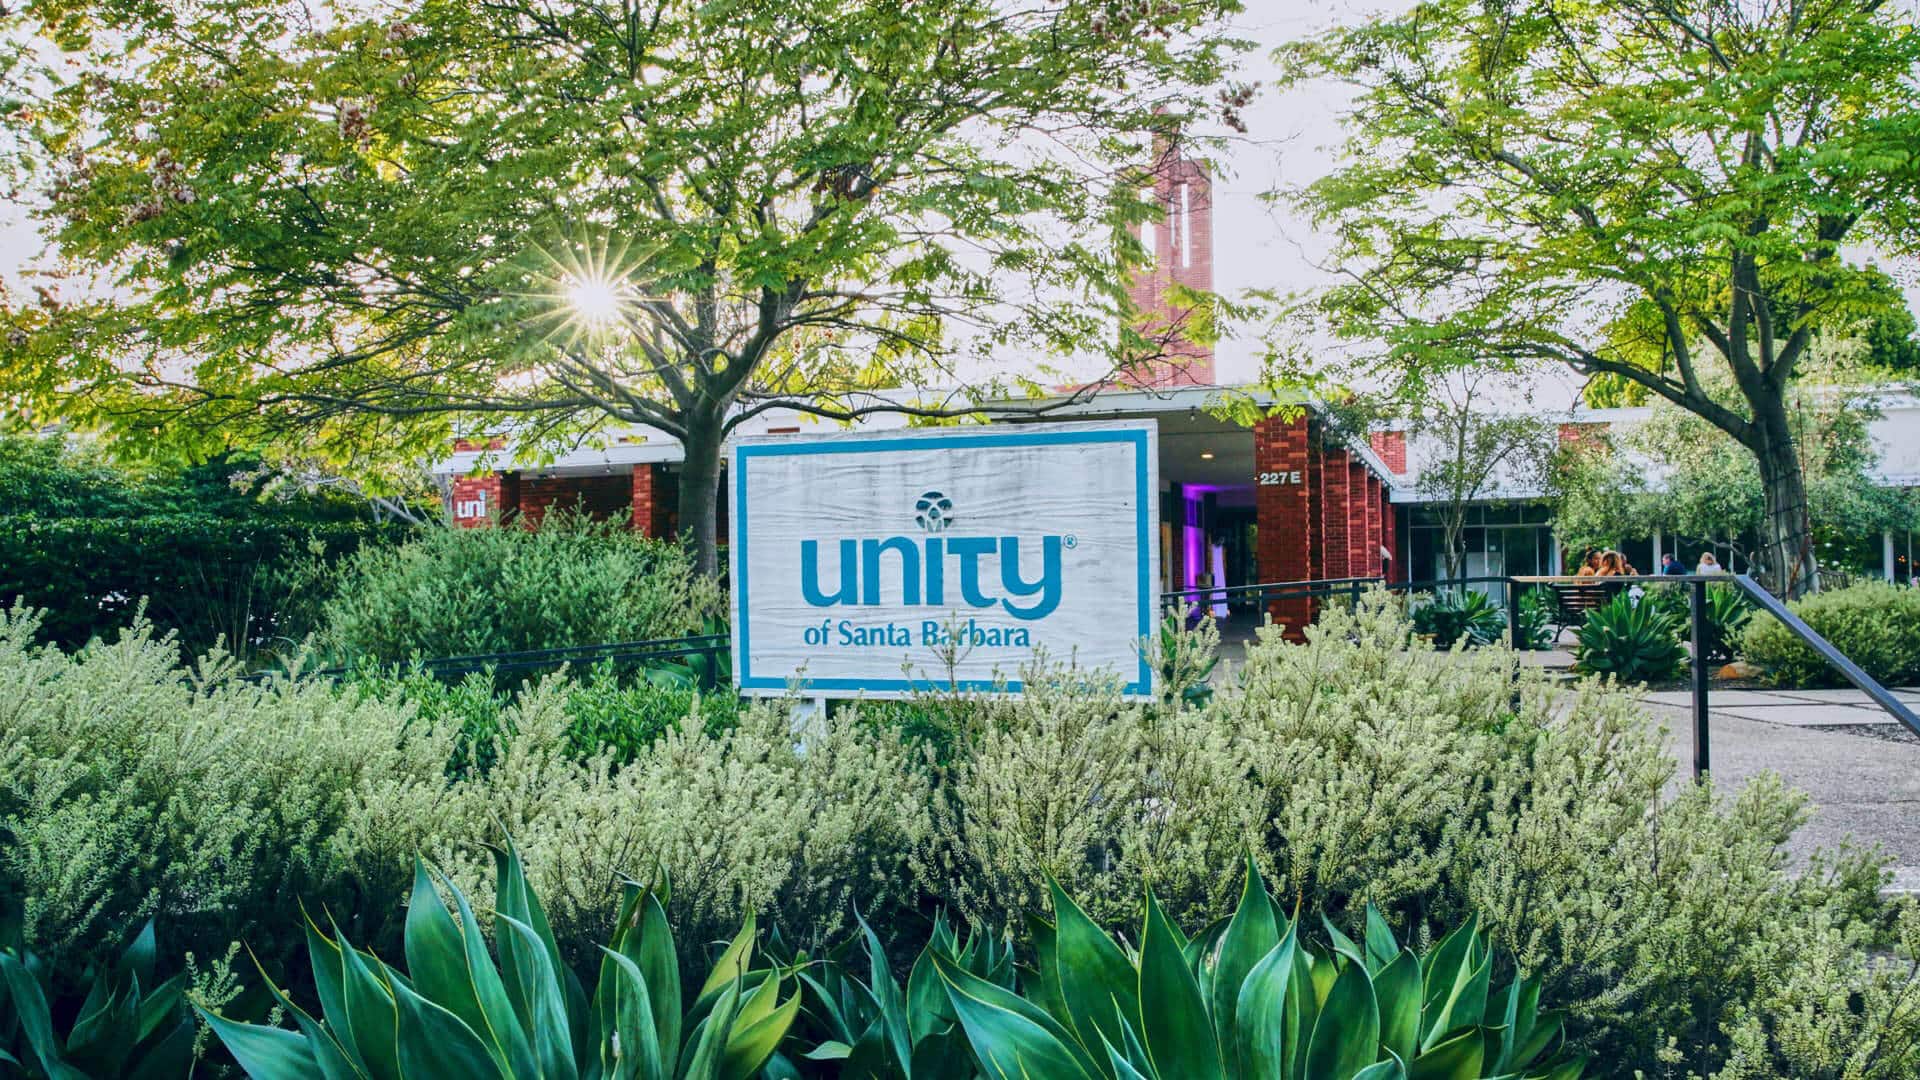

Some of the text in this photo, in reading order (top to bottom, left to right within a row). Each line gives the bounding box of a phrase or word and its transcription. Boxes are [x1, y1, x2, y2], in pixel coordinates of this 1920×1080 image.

[1260, 471, 1301, 485] 227 E
[804, 618, 1030, 647] of Santa Barbara
